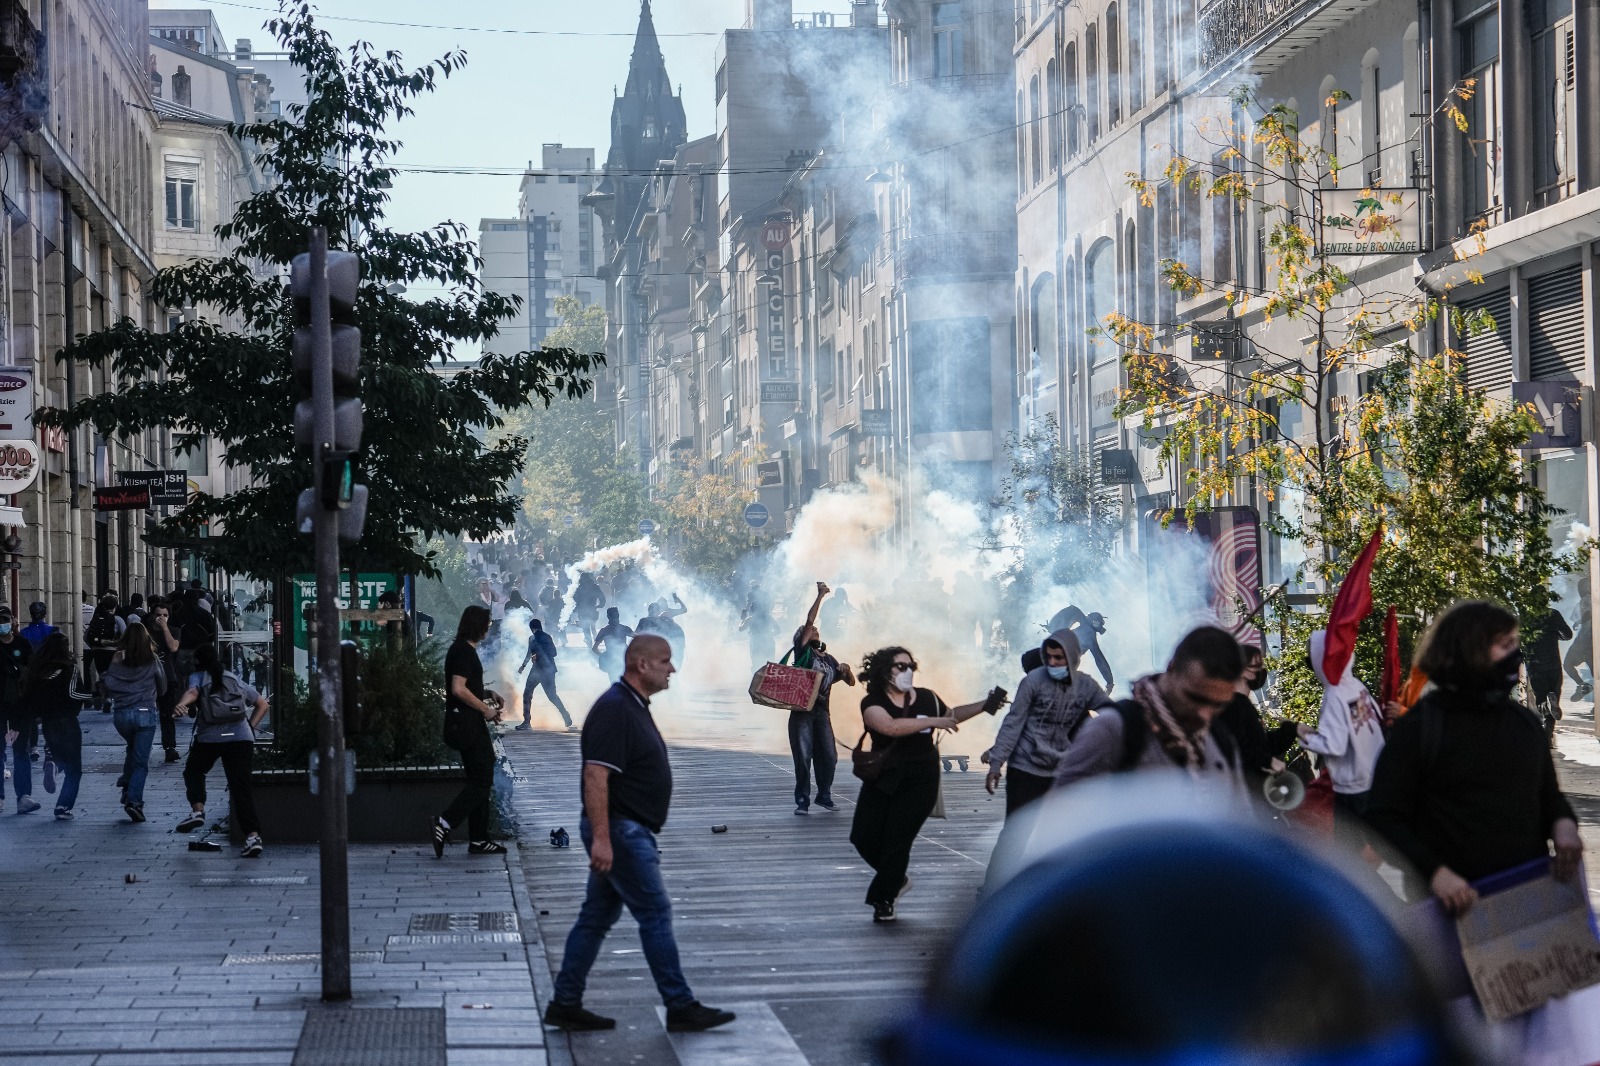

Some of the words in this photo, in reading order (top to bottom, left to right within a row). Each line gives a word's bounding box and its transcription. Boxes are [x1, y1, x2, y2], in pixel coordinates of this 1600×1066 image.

[767, 230, 783, 242] AU
[1356, 243, 1368, 252] DE
[1370, 241, 1416, 252] BRONZAGE
[768, 254, 784, 373] CACHET
[1105, 467, 1112, 475] la
[1113, 465, 1127, 478] fée
[124, 477, 148, 487] KUSMI
[150, 477, 164, 487] TEA
[766, 664, 778, 676] LE
[778, 666, 804, 677] SAC
[763, 675, 790, 684] DANS
